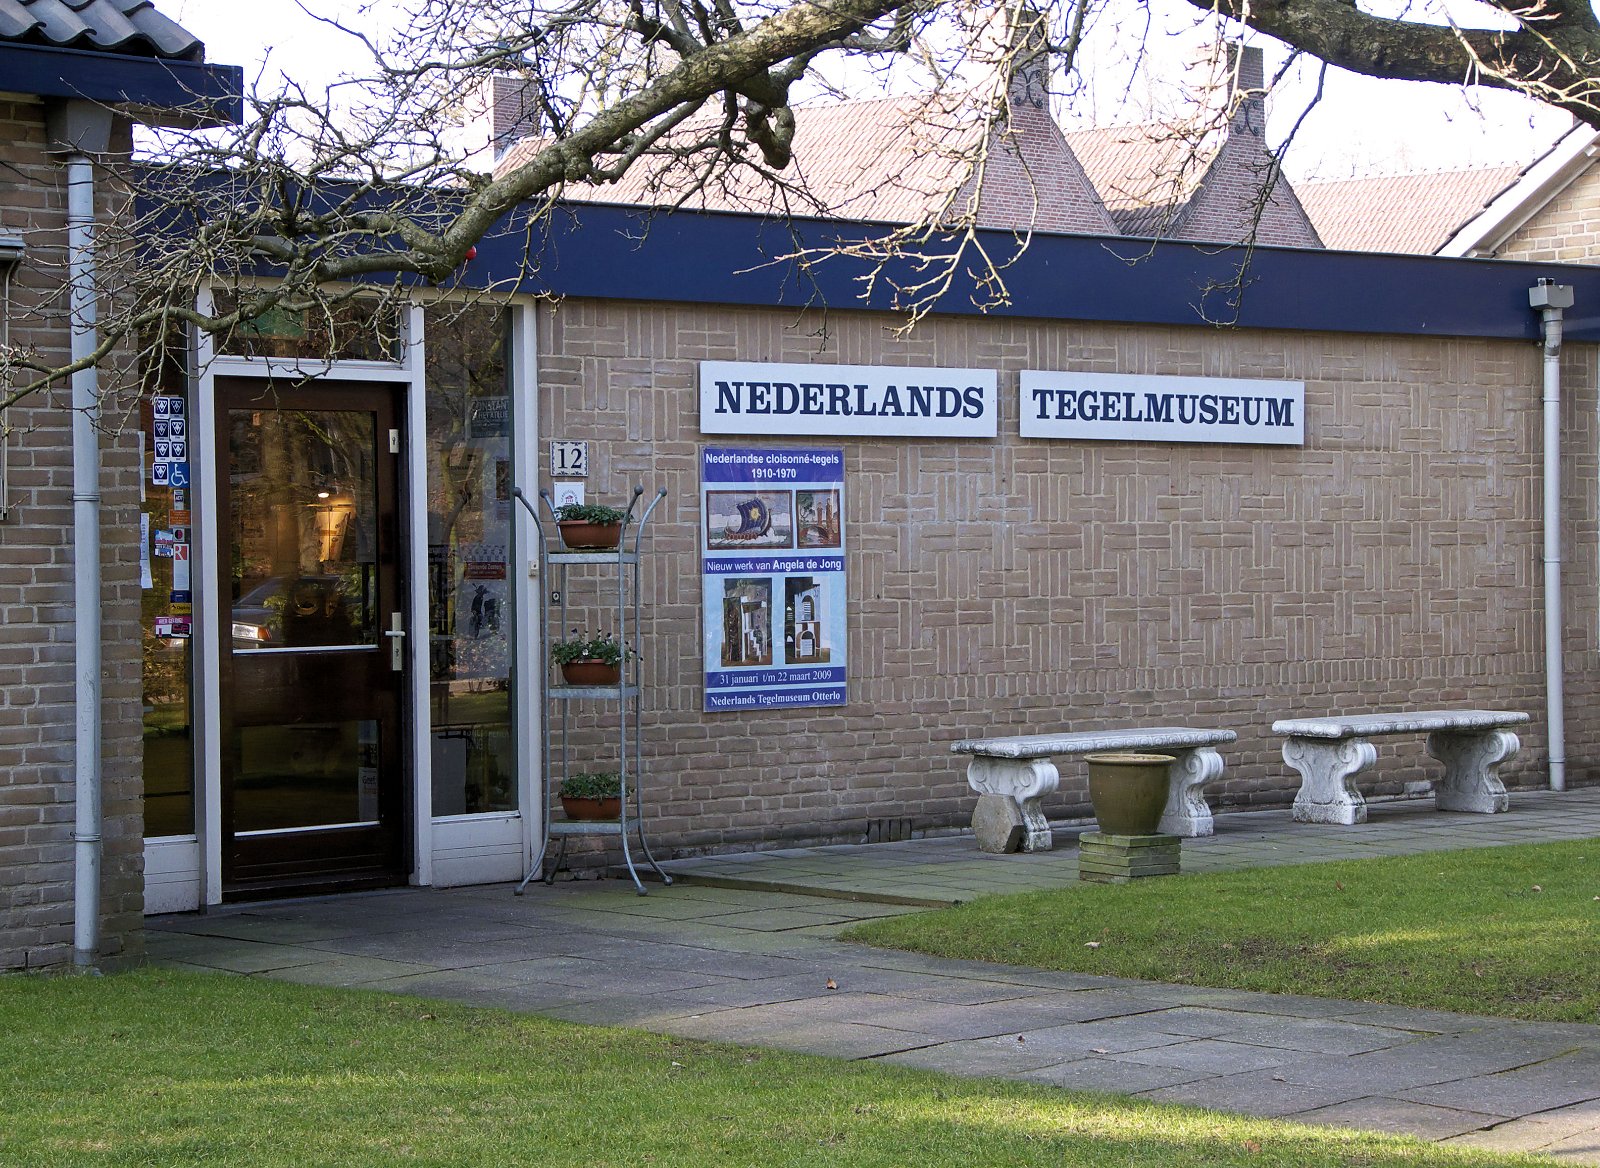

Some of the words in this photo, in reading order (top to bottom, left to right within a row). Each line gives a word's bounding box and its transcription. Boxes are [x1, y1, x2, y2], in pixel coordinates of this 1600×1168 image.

[714, 381, 984, 419] NEDERLANDS
[1032, 388, 1295, 427] TEGELMUSEUM
[558, 448, 582, 469] 12
[705, 453, 764, 464] Nederlandse
[766, 453, 839, 467] cloisonné-tegels
[751, 468, 797, 479] 1910-1970
[707, 561, 733, 571] Nieuw
[734, 561, 754, 570] werk
[755, 562, 771, 570] van
[772, 559, 804, 572] Angela
[806, 559, 818, 569] de
[819, 558, 842, 571] Jong
[720, 675, 729, 684] 31
[731, 674, 759, 686] januari
[762, 673, 776, 682] t/m
[778, 672, 787, 682] 22
[789, 671, 811, 681] maart
[812, 669, 832, 680] 2009
[711, 695, 756, 706] Nederlands
[757, 693, 810, 705] Tegelmuseum
[811, 691, 841, 701] Otterlo
